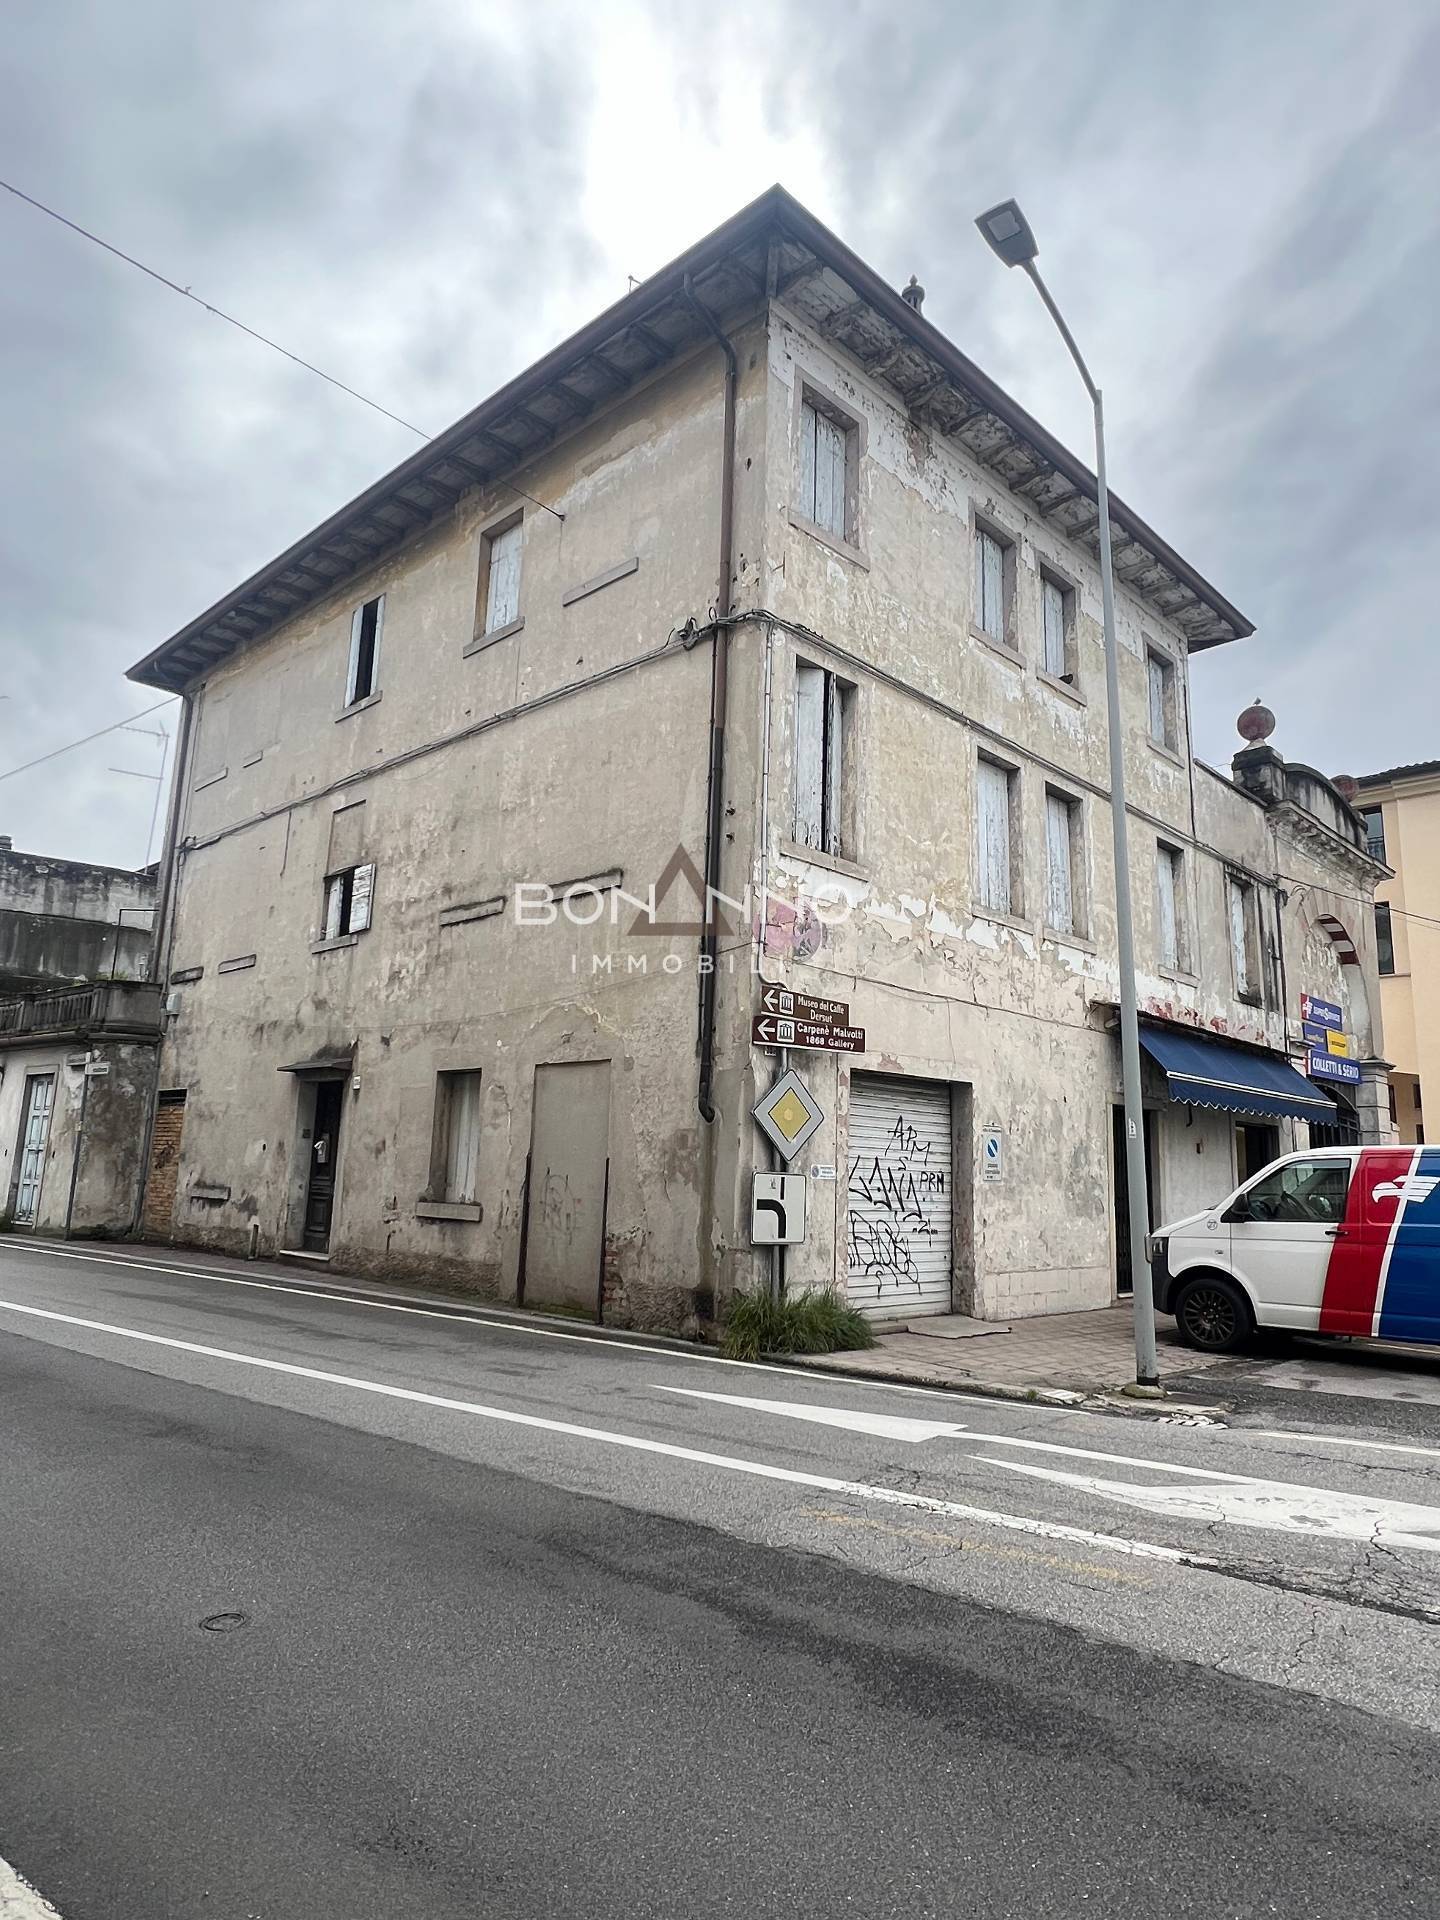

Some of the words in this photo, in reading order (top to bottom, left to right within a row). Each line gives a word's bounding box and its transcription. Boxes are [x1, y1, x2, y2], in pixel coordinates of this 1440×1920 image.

[798, 996, 818, 1008] Museo
[810, 1009, 833, 1023] Dersut
[797, 1022, 830, 1036] Carpenè
[833, 1027, 863, 1040] Malvolti
[828, 1038, 855, 1050] Gallery
